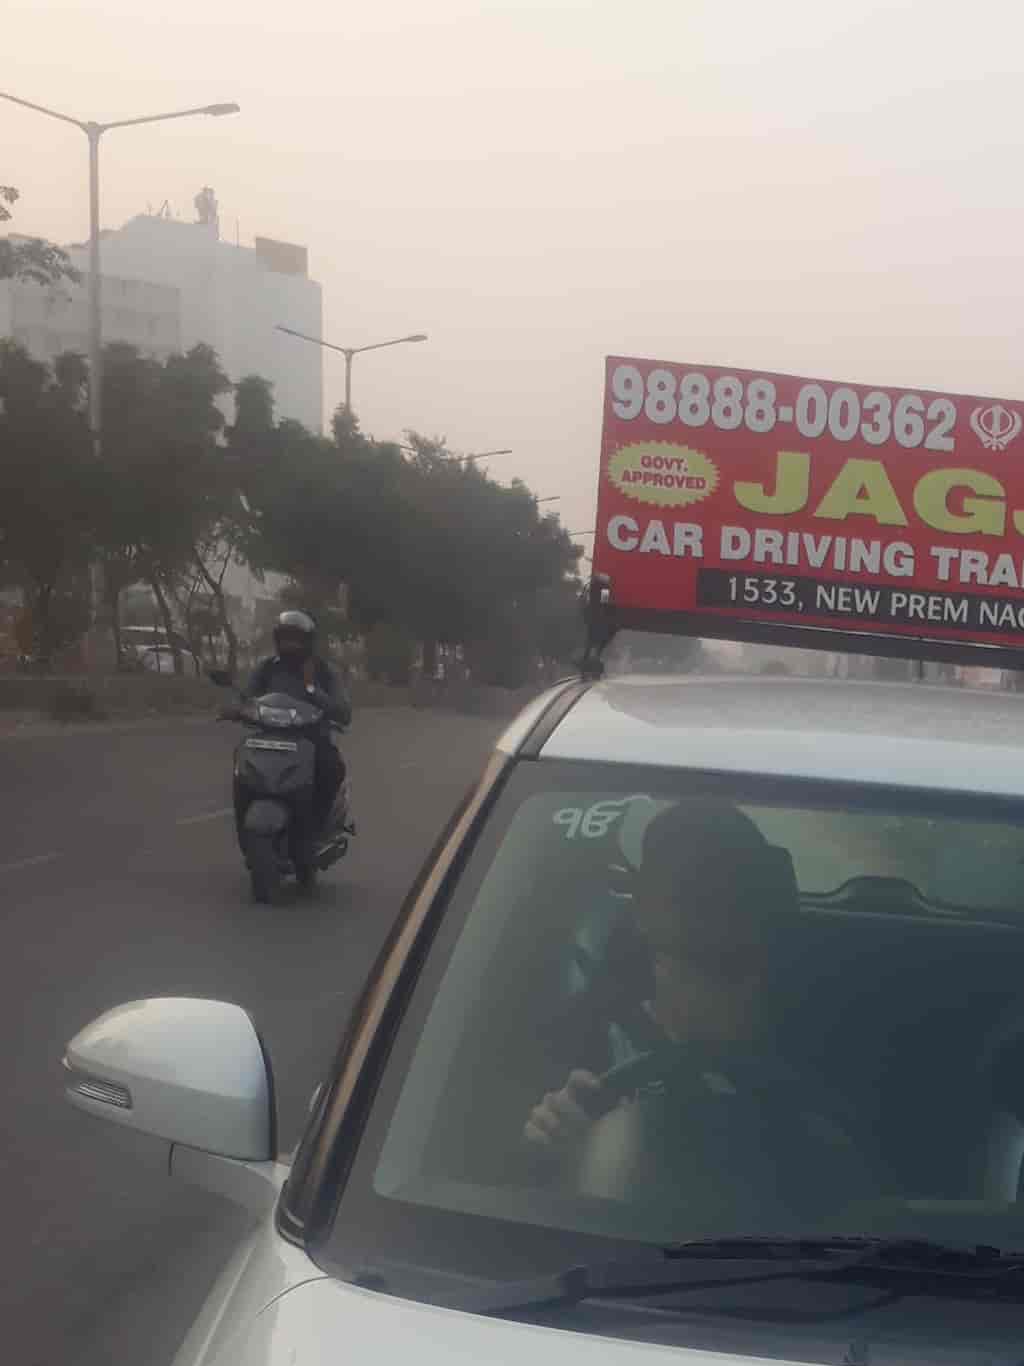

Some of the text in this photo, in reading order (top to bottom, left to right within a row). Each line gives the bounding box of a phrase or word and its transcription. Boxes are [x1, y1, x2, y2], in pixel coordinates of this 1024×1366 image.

[611, 365, 957, 451] 98888-00362
[622, 469, 706, 490] APPROVED
[640, 455, 688, 472] GOVT.
[607, 515, 704, 558] CAR
[719, 525, 916, 579] DRIVING
[728, 576, 804, 610] 1533,
[815, 585, 881, 615] NEW
[890, 591, 968, 622] PREM
